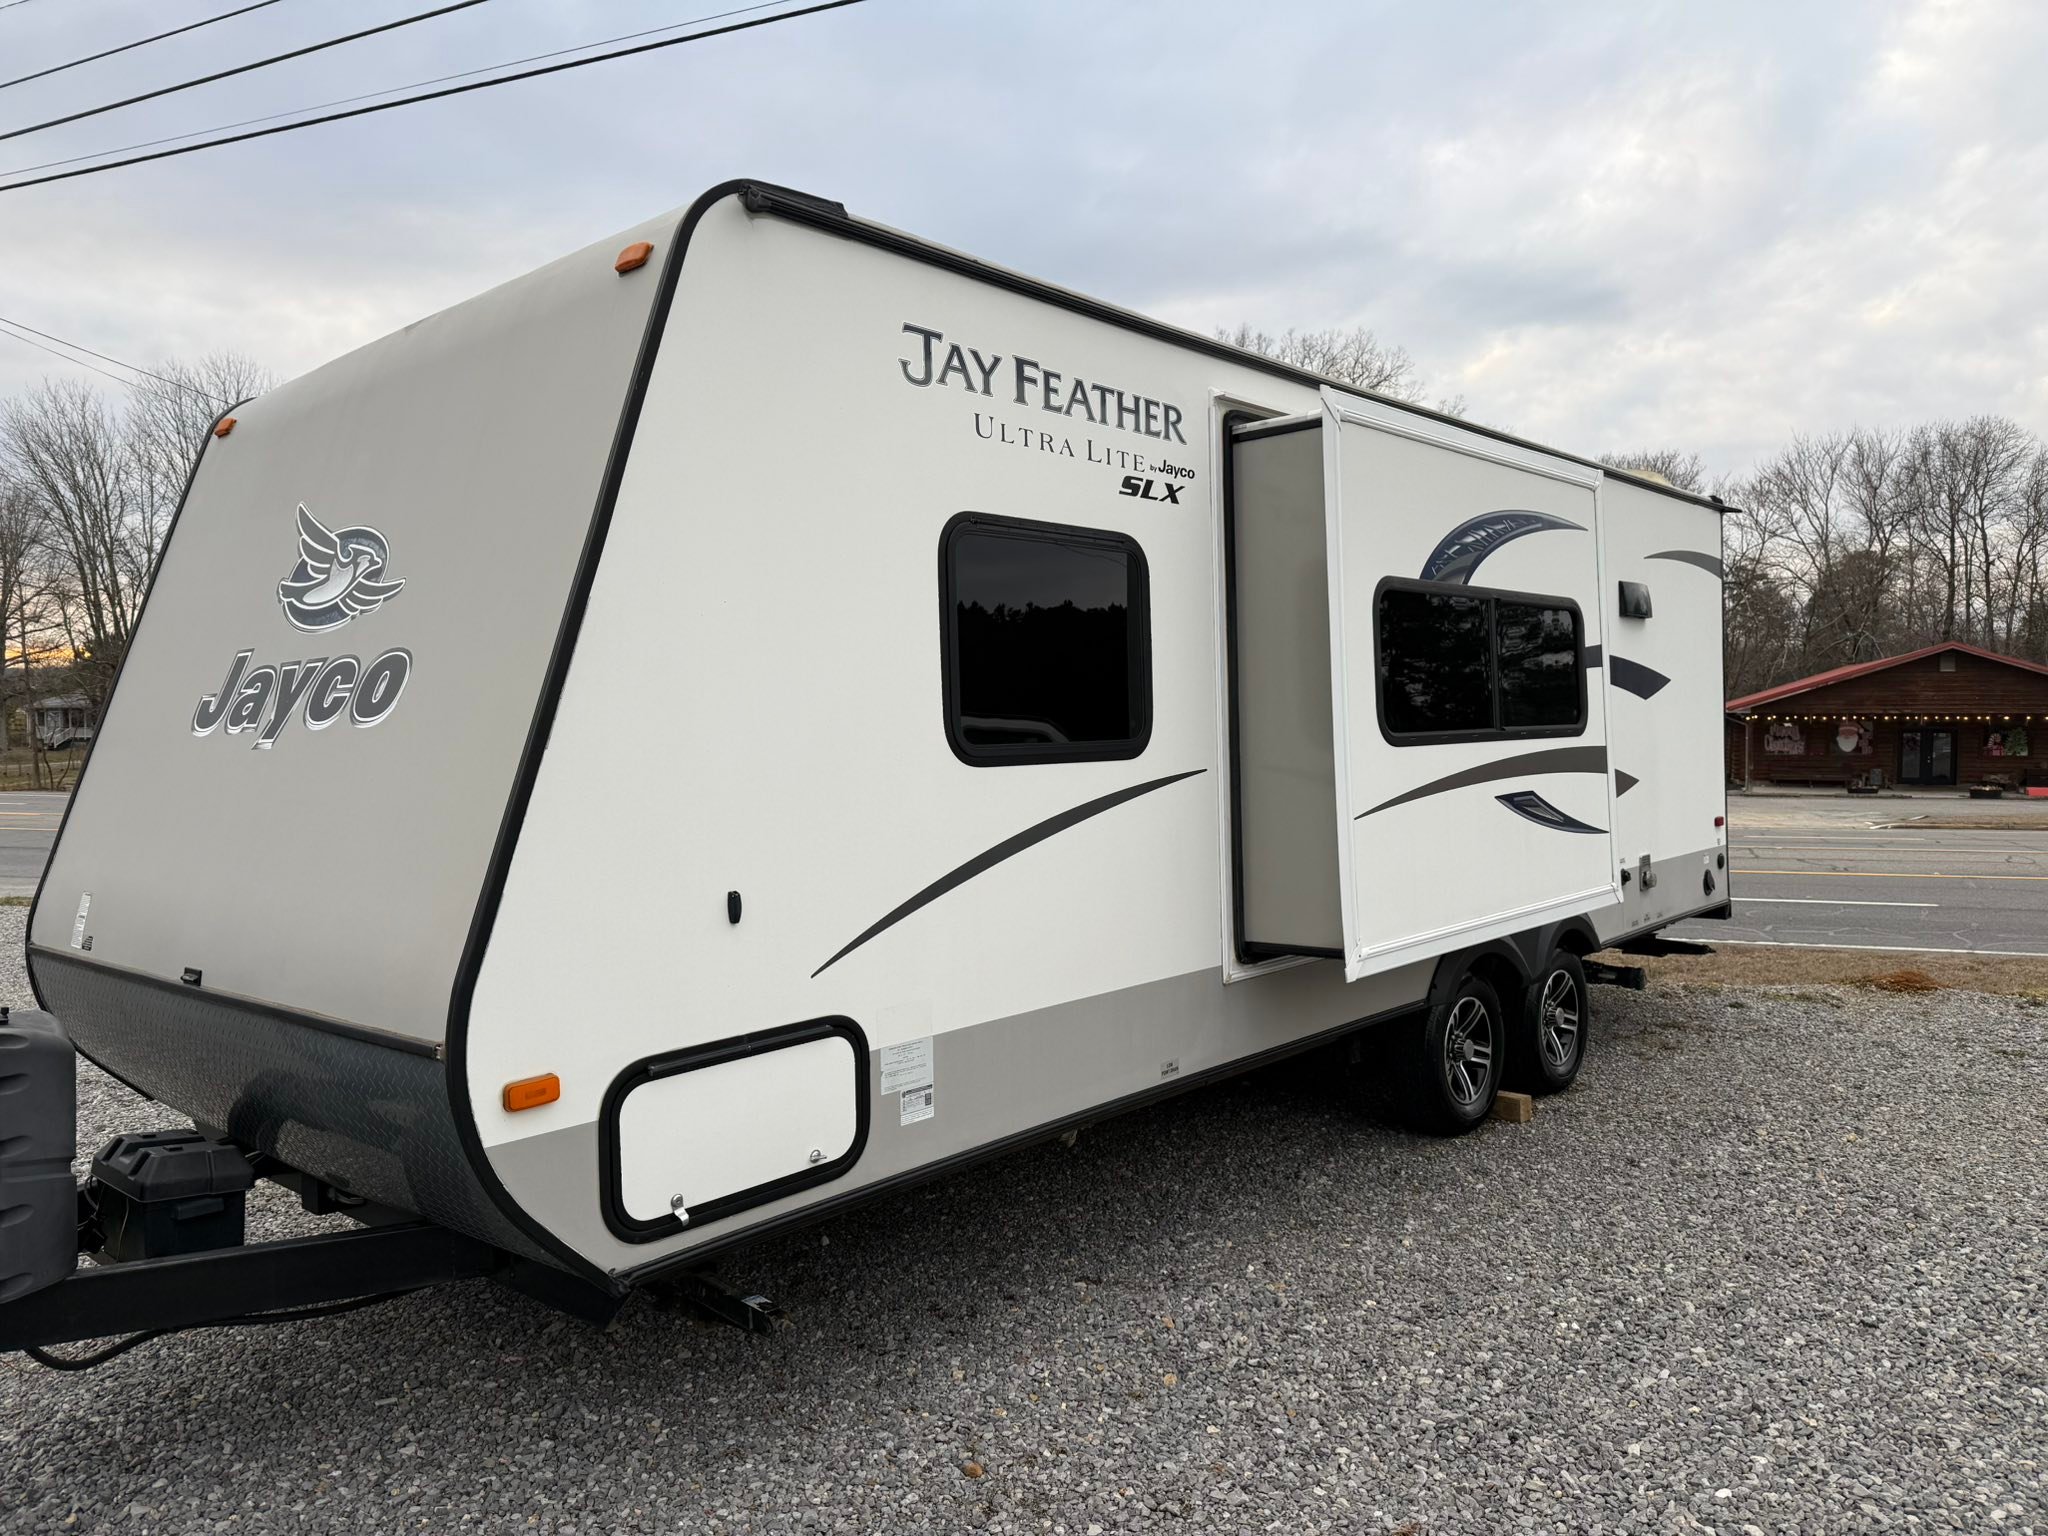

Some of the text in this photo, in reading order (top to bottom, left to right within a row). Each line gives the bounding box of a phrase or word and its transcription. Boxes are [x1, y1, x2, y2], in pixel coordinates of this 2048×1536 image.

[898, 322, 1188, 445] JAY FEATHER
[974, 412, 1075, 458] ULTRA
[1087, 439, 1146, 473] LITE
[1158, 459, 1195, 479] Jayco
[1119, 475, 1185, 505] SLX
[191, 647, 413, 751] Jayco
